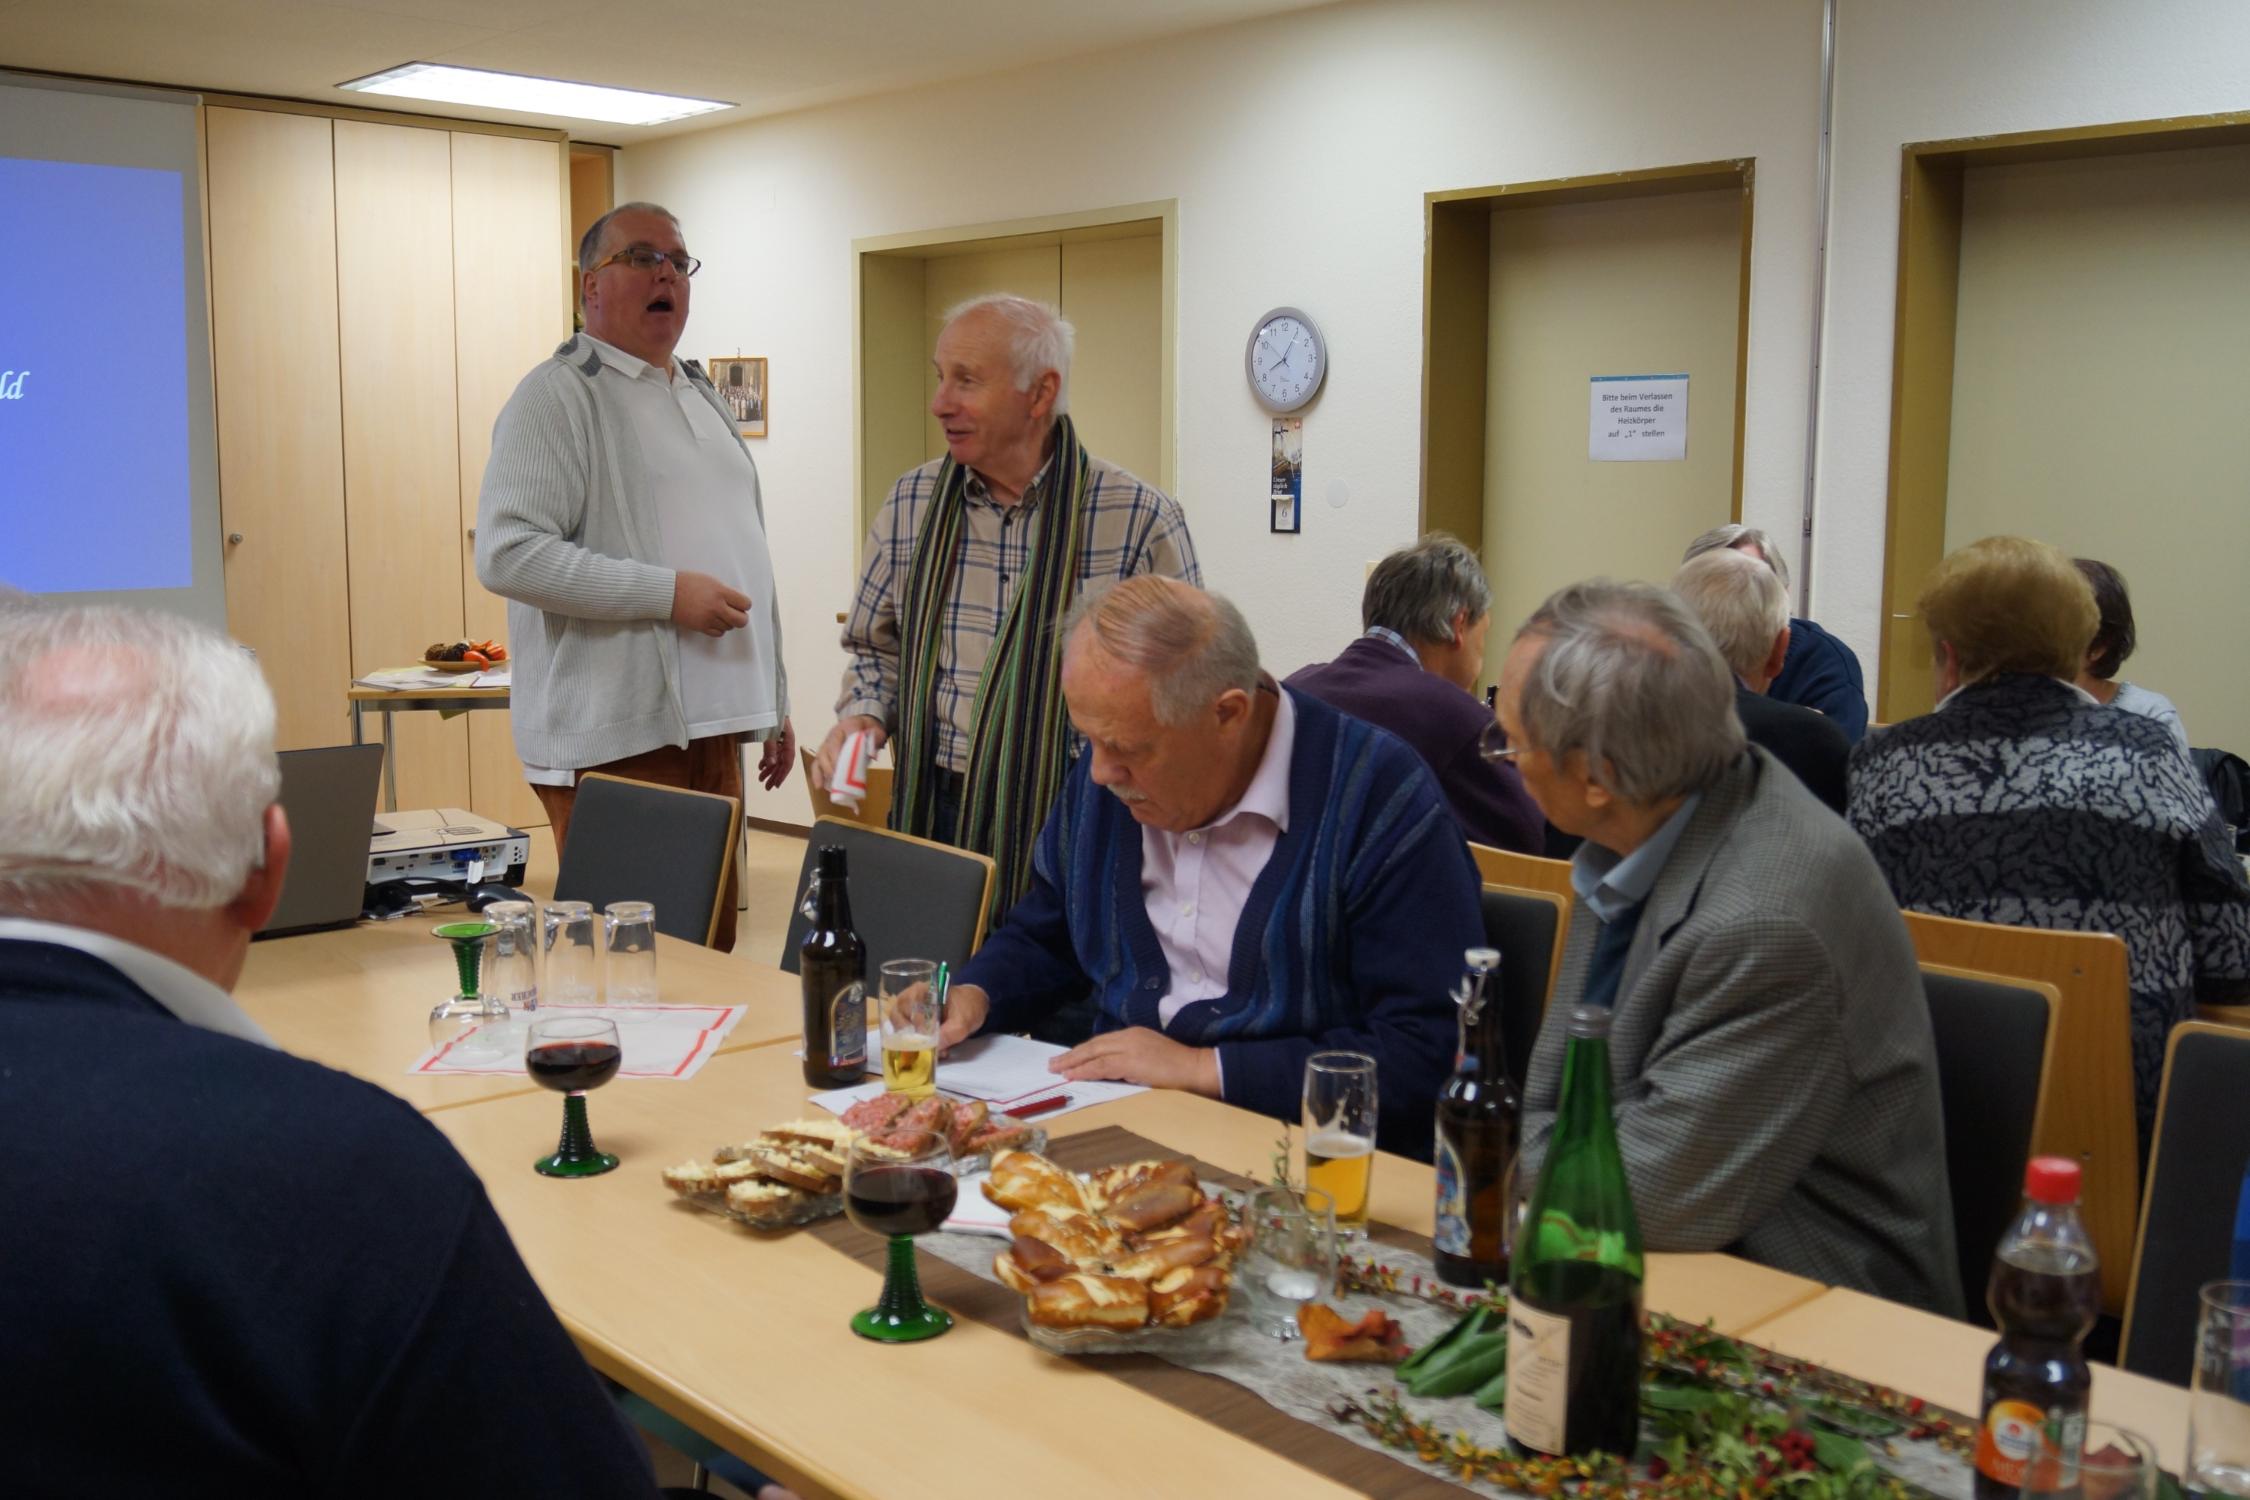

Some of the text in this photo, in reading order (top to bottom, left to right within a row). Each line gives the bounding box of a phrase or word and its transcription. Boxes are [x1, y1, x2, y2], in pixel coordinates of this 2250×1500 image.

[1281, 322, 1288, 331] 12
[1270, 328, 1277, 336] 11
[1261, 341, 1269, 350] 10
[1304, 339, 1309, 347] 2
[1258, 357, 1263, 365] 9
[1308, 354, 1313, 363] 3
[1262, 373, 1267, 382] 8
[1304, 372, 1309, 380] 4
[1271, 384, 1276, 392] 7
[1295, 384, 1300, 392] 5
[1282, 389, 1287, 397] 6
[1620, 393, 1637, 401] beim
[1610, 404, 1664, 413] des Raumes die
[1608, 430, 1619, 438] auf
[1282, 507, 1287, 518] 6
